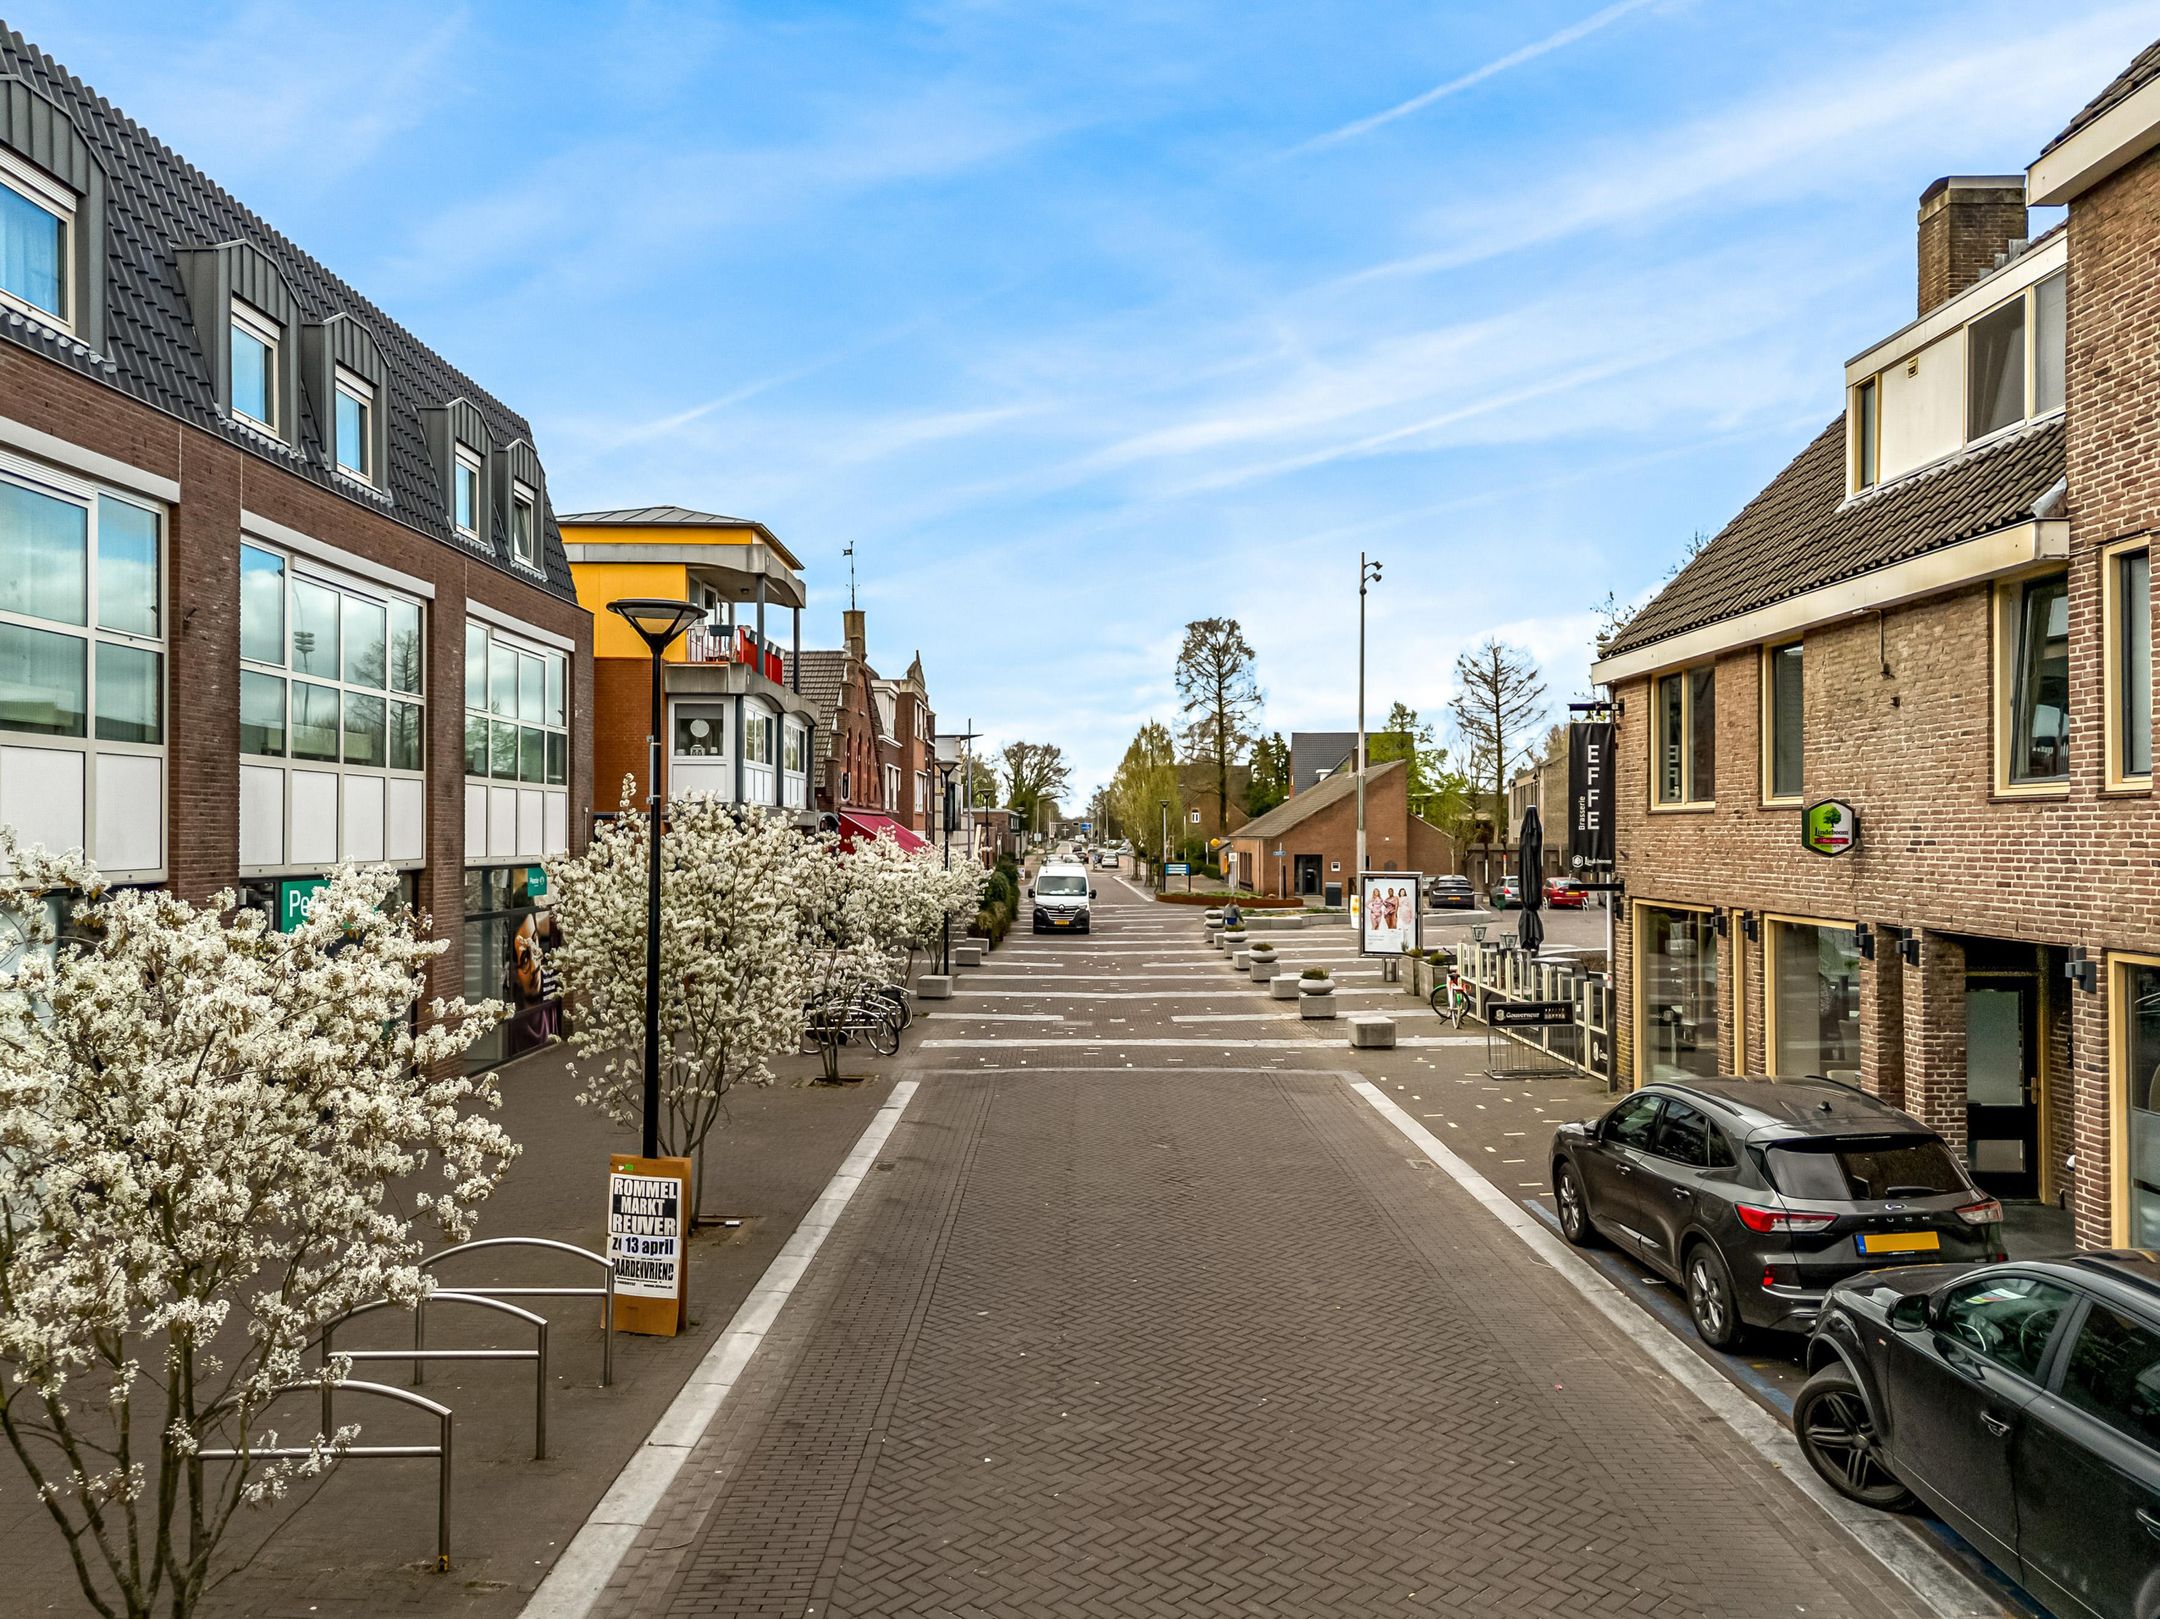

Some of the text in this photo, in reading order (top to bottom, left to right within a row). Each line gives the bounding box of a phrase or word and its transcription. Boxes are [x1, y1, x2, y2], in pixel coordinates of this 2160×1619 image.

[1587, 745, 1600, 830] EFFE
[1578, 796, 1586, 831] Brasserie
[613, 1178, 677, 1199] ROMMEL
[620, 1196, 665, 1216] MARKT
[612, 1213, 677, 1236] REUVER
[625, 1236, 639, 1253] 13
[641, 1238, 674, 1256] april
